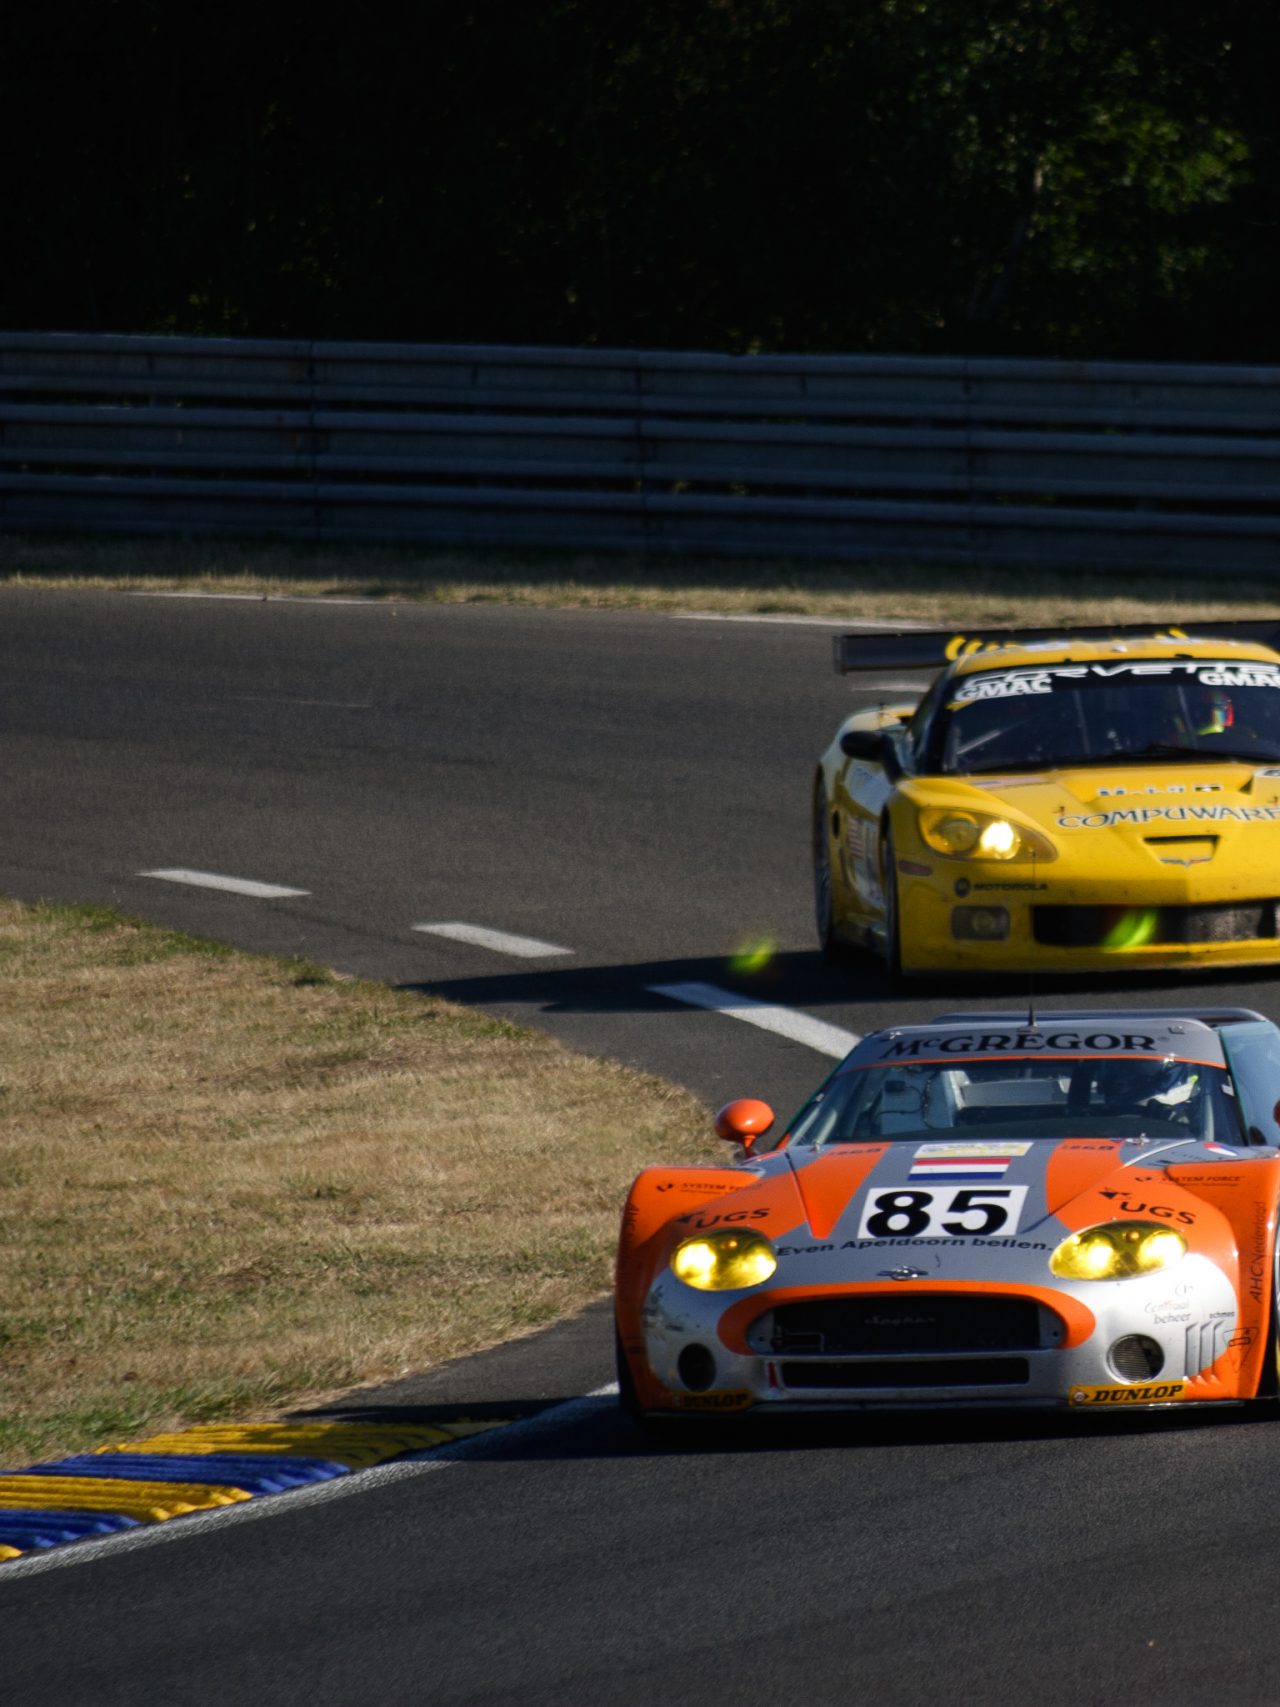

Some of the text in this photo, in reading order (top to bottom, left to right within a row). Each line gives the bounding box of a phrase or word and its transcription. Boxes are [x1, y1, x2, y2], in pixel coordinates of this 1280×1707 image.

[954, 678, 1052, 702] GMAC
[972, 882, 1048, 892] MOTOROLA
[879, 1033, 1157, 1060] McGREGOR
[695, 1207, 771, 1229] UGS
[866, 1190, 1012, 1238] 85
[1120, 1201, 1196, 1225] UGS
[777, 1243, 834, 1257] Even
[840, 1237, 962, 1250] Apeldoorn
[1093, 1385, 1184, 1401] DUNLOP
